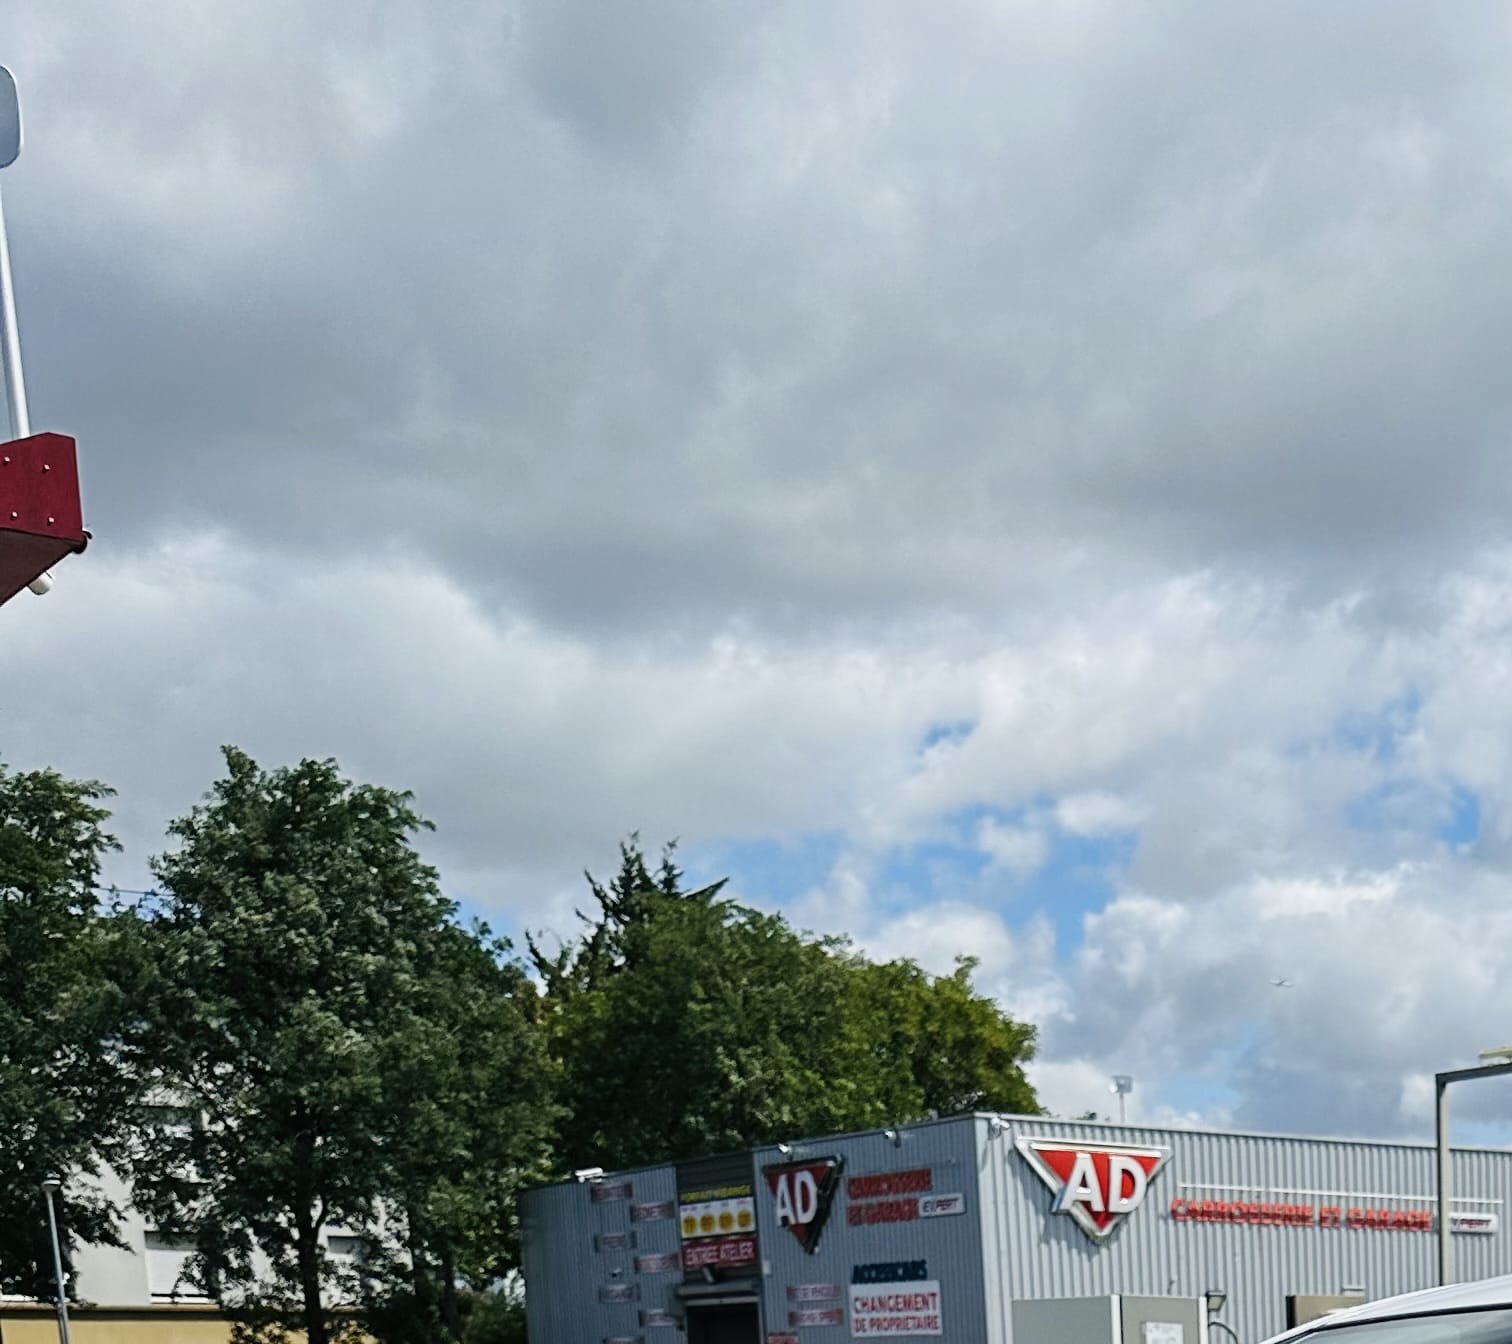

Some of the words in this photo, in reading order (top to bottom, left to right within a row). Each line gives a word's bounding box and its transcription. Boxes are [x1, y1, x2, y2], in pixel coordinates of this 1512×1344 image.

[776, 1169, 818, 1227] AD
[1051, 1151, 1148, 1214] AD
[854, 1293, 937, 1313] CHANGEMENT
[855, 1317, 867, 1332] DE
